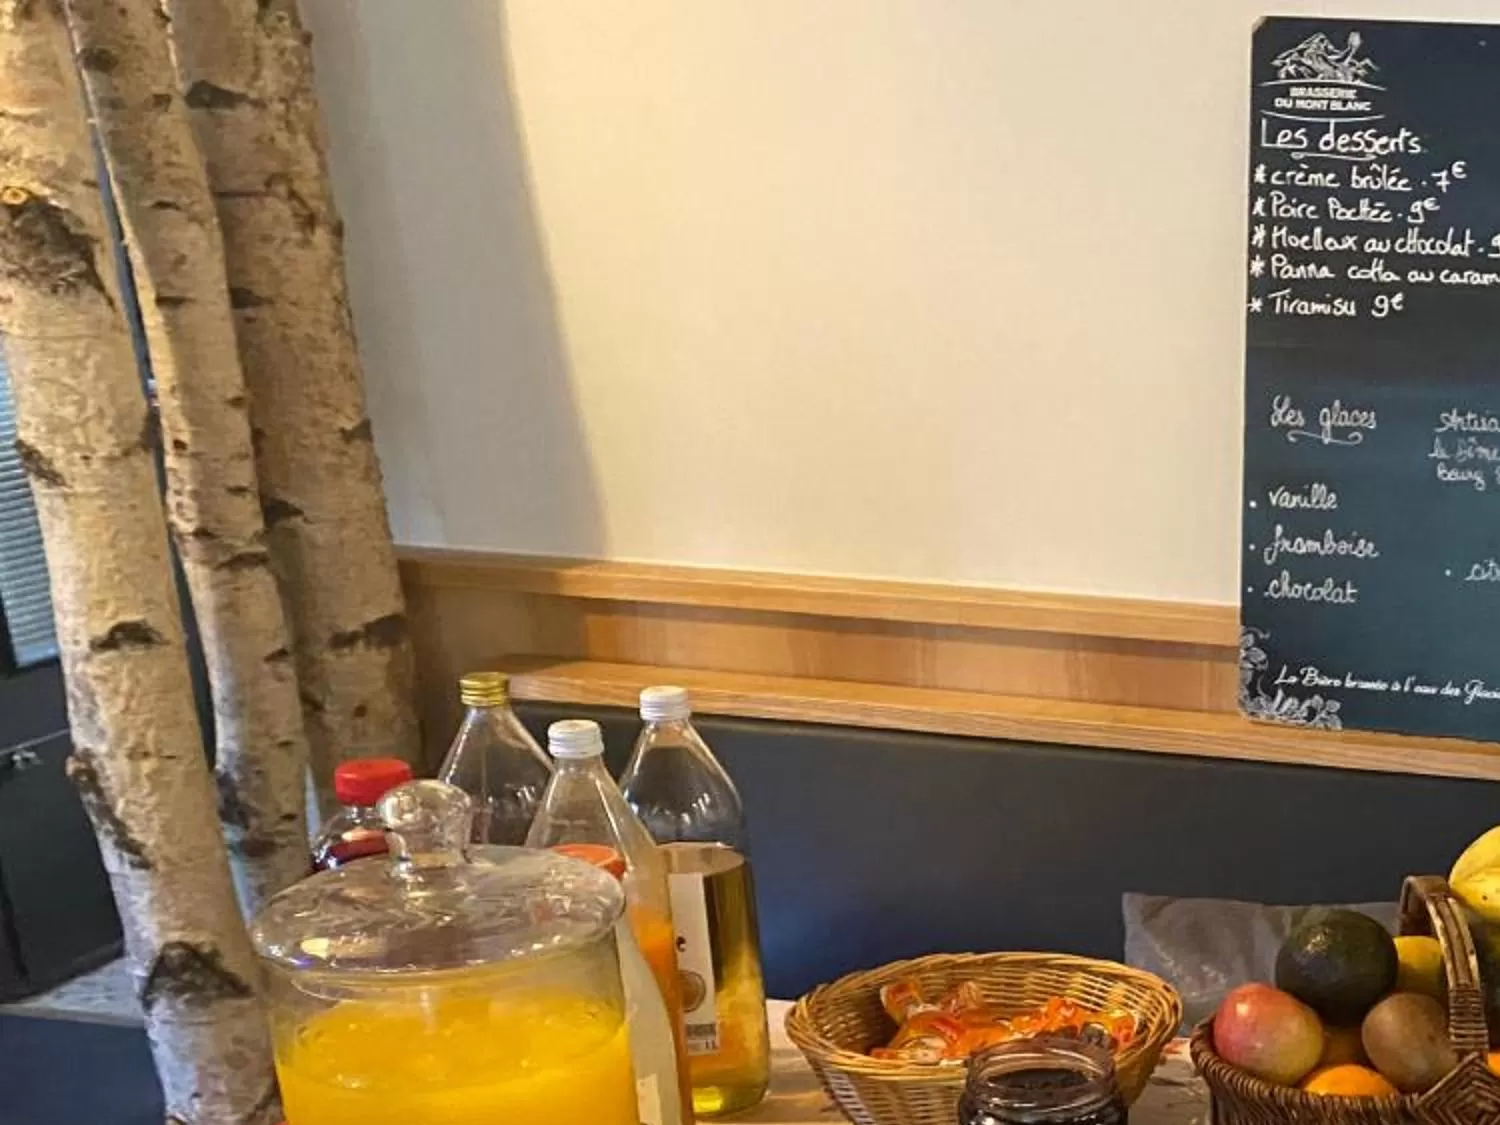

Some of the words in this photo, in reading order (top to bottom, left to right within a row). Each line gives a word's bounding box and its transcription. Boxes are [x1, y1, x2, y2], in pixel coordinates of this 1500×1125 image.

[1274, 98, 1292, 108] DU
[1296, 100, 1327, 110] MONT
[1330, 101, 1371, 111] BLANC
[1261, 118, 1308, 149] Les
[1270, 163, 1340, 187] crème
[1351, 164, 1413, 190] brûlée
[1270, 190, 1319, 219] Poire
[1364, 237, 1391, 252] au
[1271, 253, 1336, 279] Panna
[1347, 257, 1401, 282] cotta
[1407, 270, 1434, 283] au
[1267, 288, 1357, 316] Tiramisu
[1270, 395, 1305, 427] Les
[1319, 399, 1376, 444] glaces
[1268, 482, 1338, 510] vanille
[1263, 524, 1380, 565] framboise
[1265, 569, 1358, 604] chocolat
